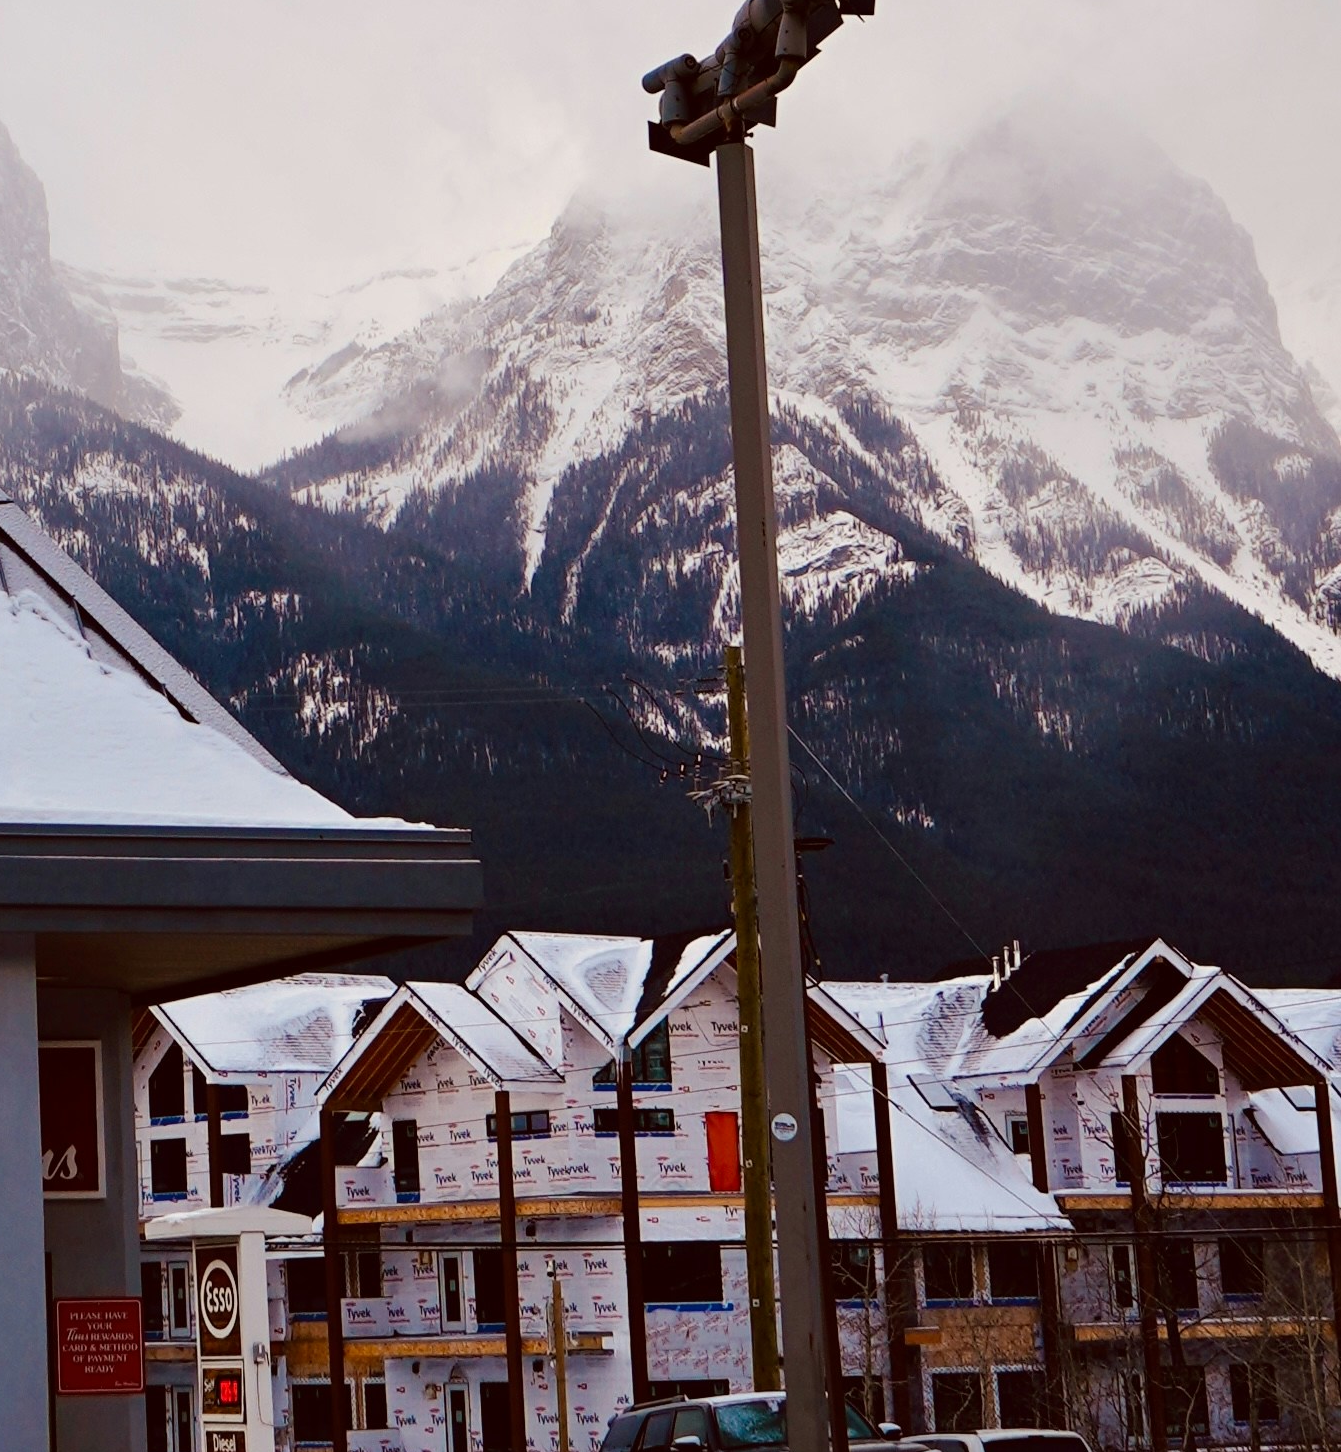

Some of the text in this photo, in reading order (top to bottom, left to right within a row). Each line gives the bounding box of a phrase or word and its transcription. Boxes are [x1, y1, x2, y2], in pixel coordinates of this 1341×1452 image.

[478, 948, 498, 973] Tyvek
[570, 1003, 591, 1025] Tyvek
[452, 1035, 472, 1058] Tyvek
[325, 1068, 343, 1091] Tyvek
[400, 1078, 421, 1090] Tyvek
[287, 1078, 296, 1109] Tyvek
[251, 1095, 270, 1107] Tyek
[450, 1129, 471, 1140] Tyvek
[523, 1155, 545, 1165] Tyvek
[548, 1165, 569, 1177] Tyvek
[658, 1162, 686, 1175] Tyvek
[435, 1174, 456, 1185] Tyvek
[471, 1170, 494, 1182] Tyvek
[346, 1186, 370, 1198] Tyvek
[584, 1259, 607, 1271] Tyvek
[206, 1280, 233, 1313] Esso
[347, 1308, 371, 1321] Tyvek
[593, 1302, 617, 1315] Tyvek
[70, 1311, 128, 1320] PLEASE HAVE
[87, 1322, 112, 1330] YOUR
[90, 1332, 134, 1341] REWARDS
[62, 1343, 138, 1352] CARD & METHOD
[73, 1354, 127, 1363] OF PAYMENT
[85, 1365, 114, 1373] READY
[395, 1415, 417, 1427] Tyvek
[576, 1413, 599, 1425] Tyvek
[212, 1433, 236, 1452] Diesel
